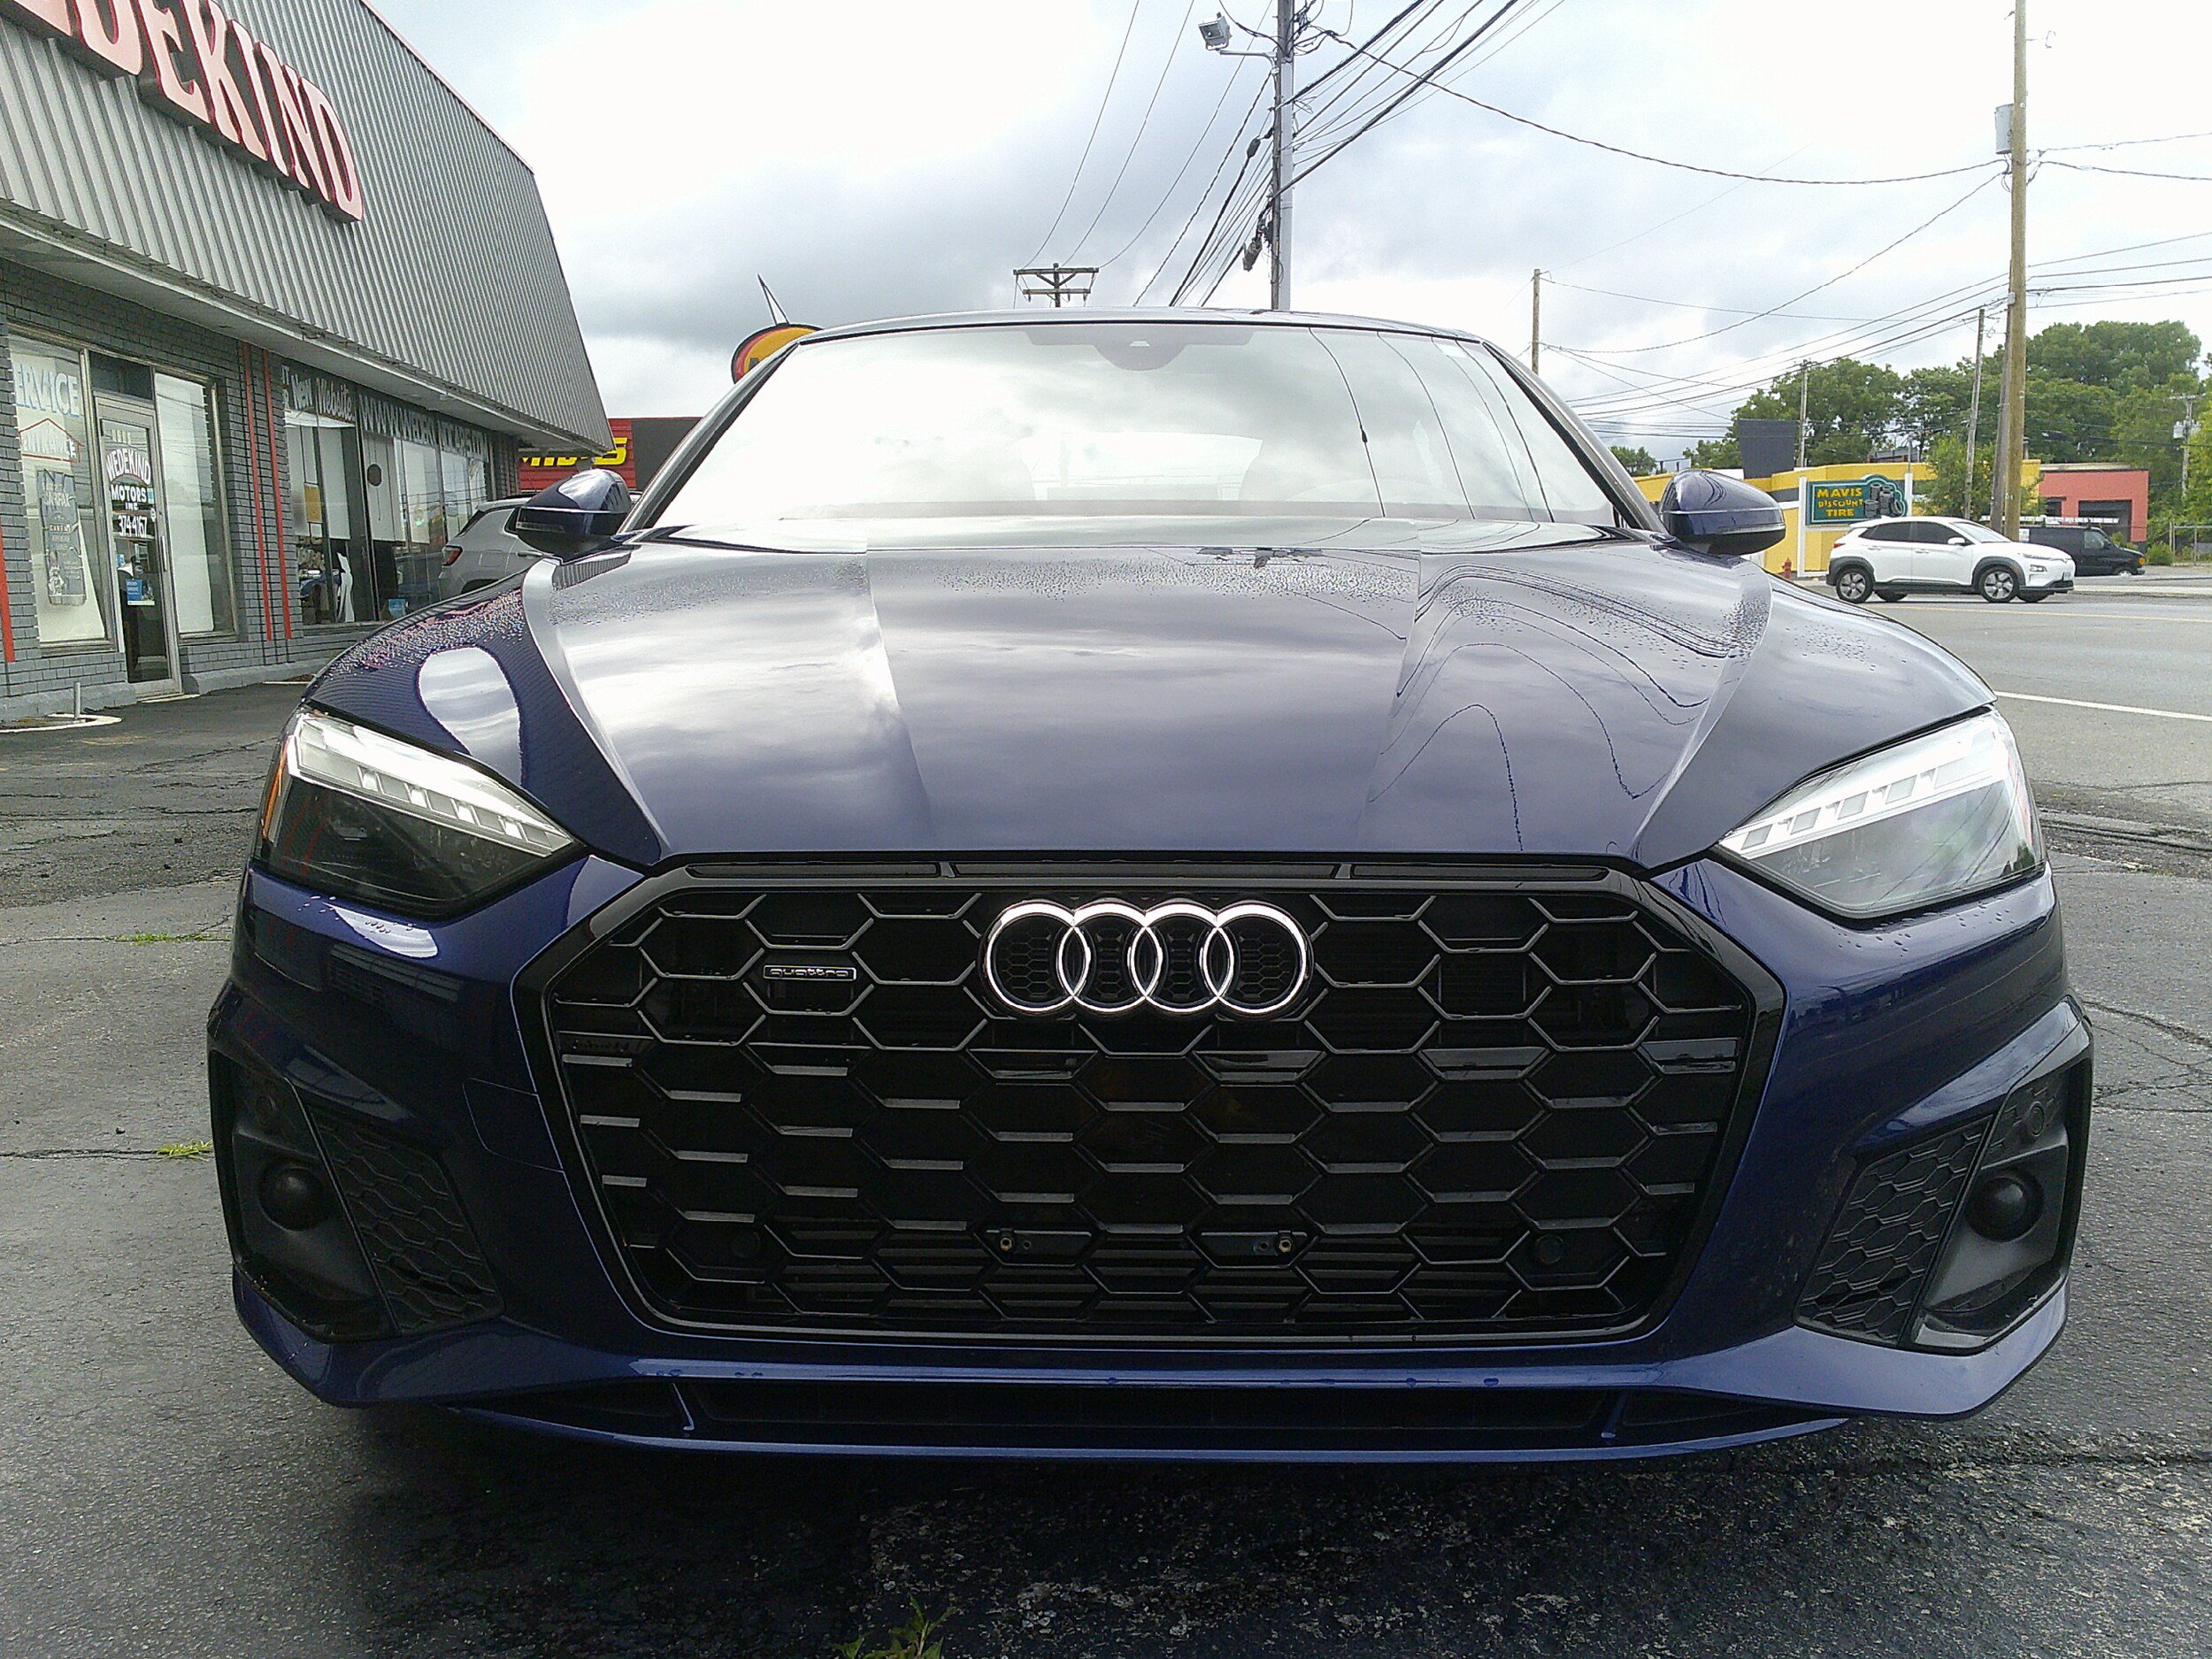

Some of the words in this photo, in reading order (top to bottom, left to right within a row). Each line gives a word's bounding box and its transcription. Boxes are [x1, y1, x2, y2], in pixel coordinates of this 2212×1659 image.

[12, 0, 364, 221] EKIND
[106, 449, 150, 485] WEDEKIND
[111, 484, 147, 503] MOTORS
[1816, 488, 1863, 498] MAVIS
[1818, 499, 1863, 509] DISCOUNT
[770, 967, 849, 978] quattro
